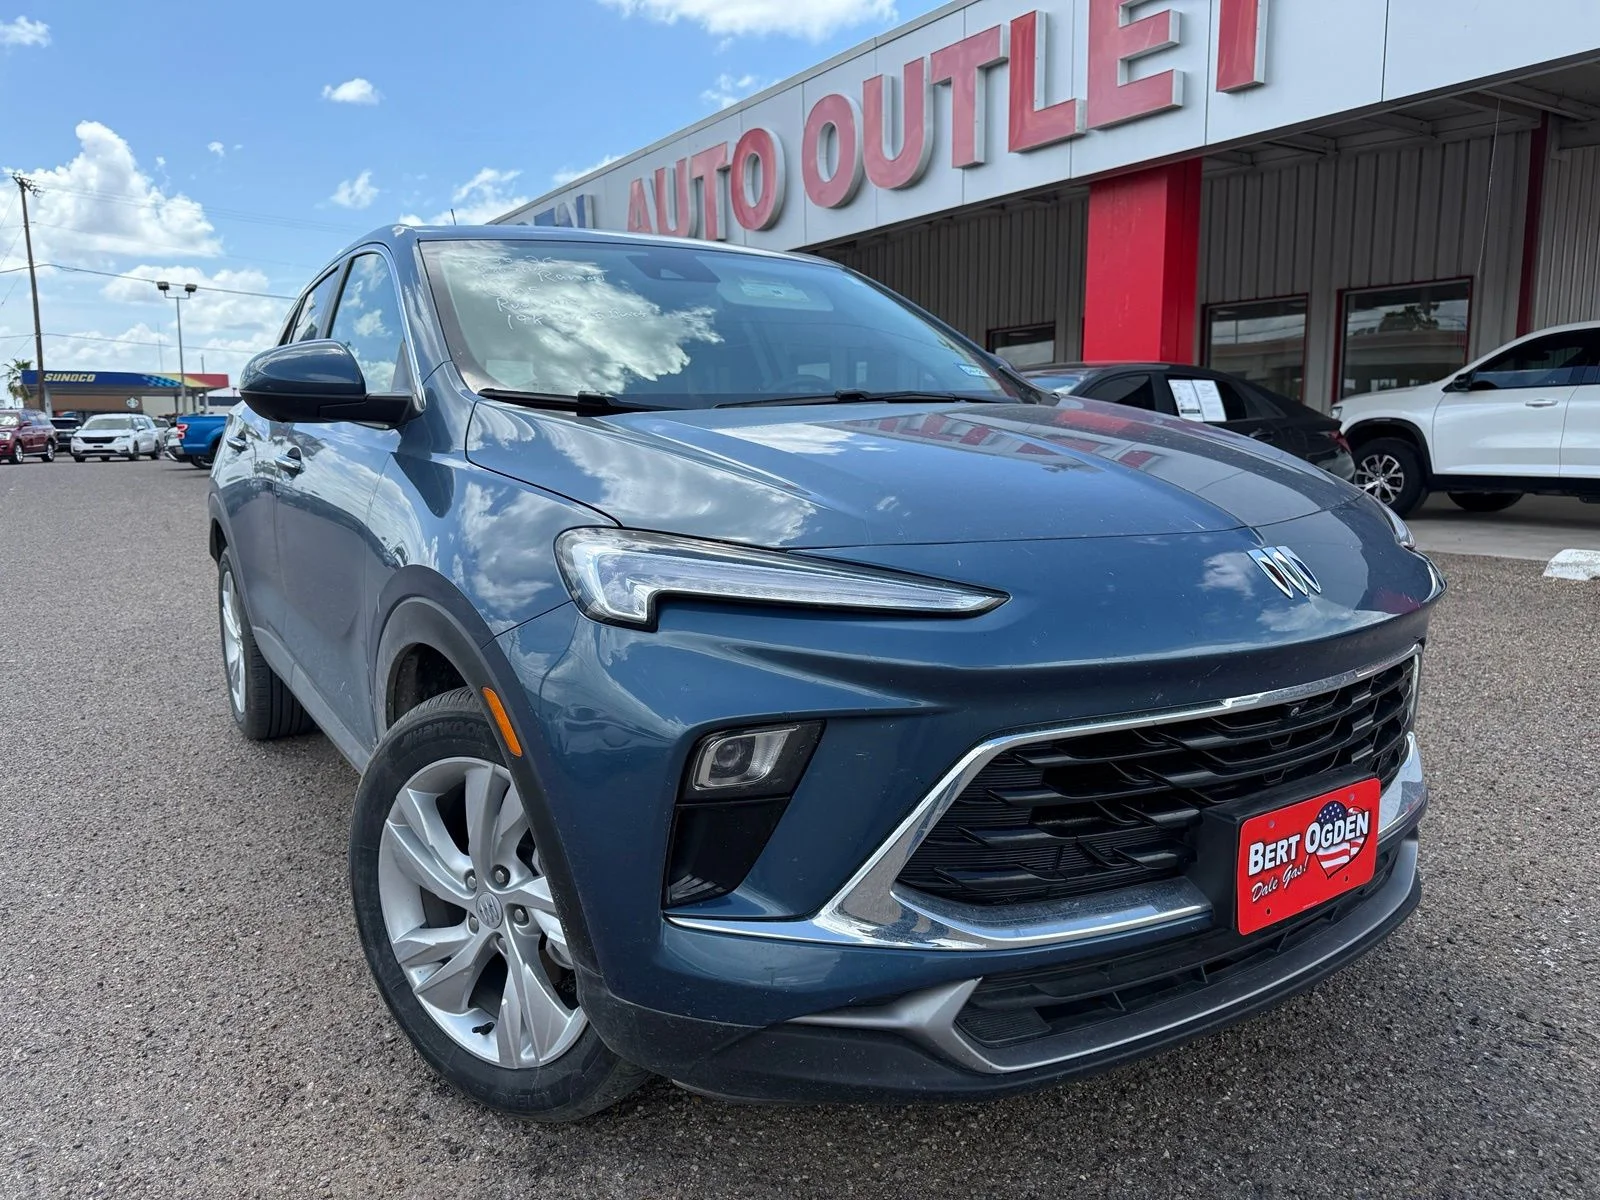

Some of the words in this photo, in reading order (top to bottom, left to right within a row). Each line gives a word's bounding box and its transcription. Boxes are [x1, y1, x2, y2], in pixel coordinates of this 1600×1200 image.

[627, 127, 783, 241] AUTO
[44, 373, 96, 382] SUNOCO
[1248, 834, 1301, 876] BERT
[1305, 811, 1369, 854] OGDEN
[1251, 876, 1278, 903] Dale
[1282, 855, 1309, 889] Gas!
